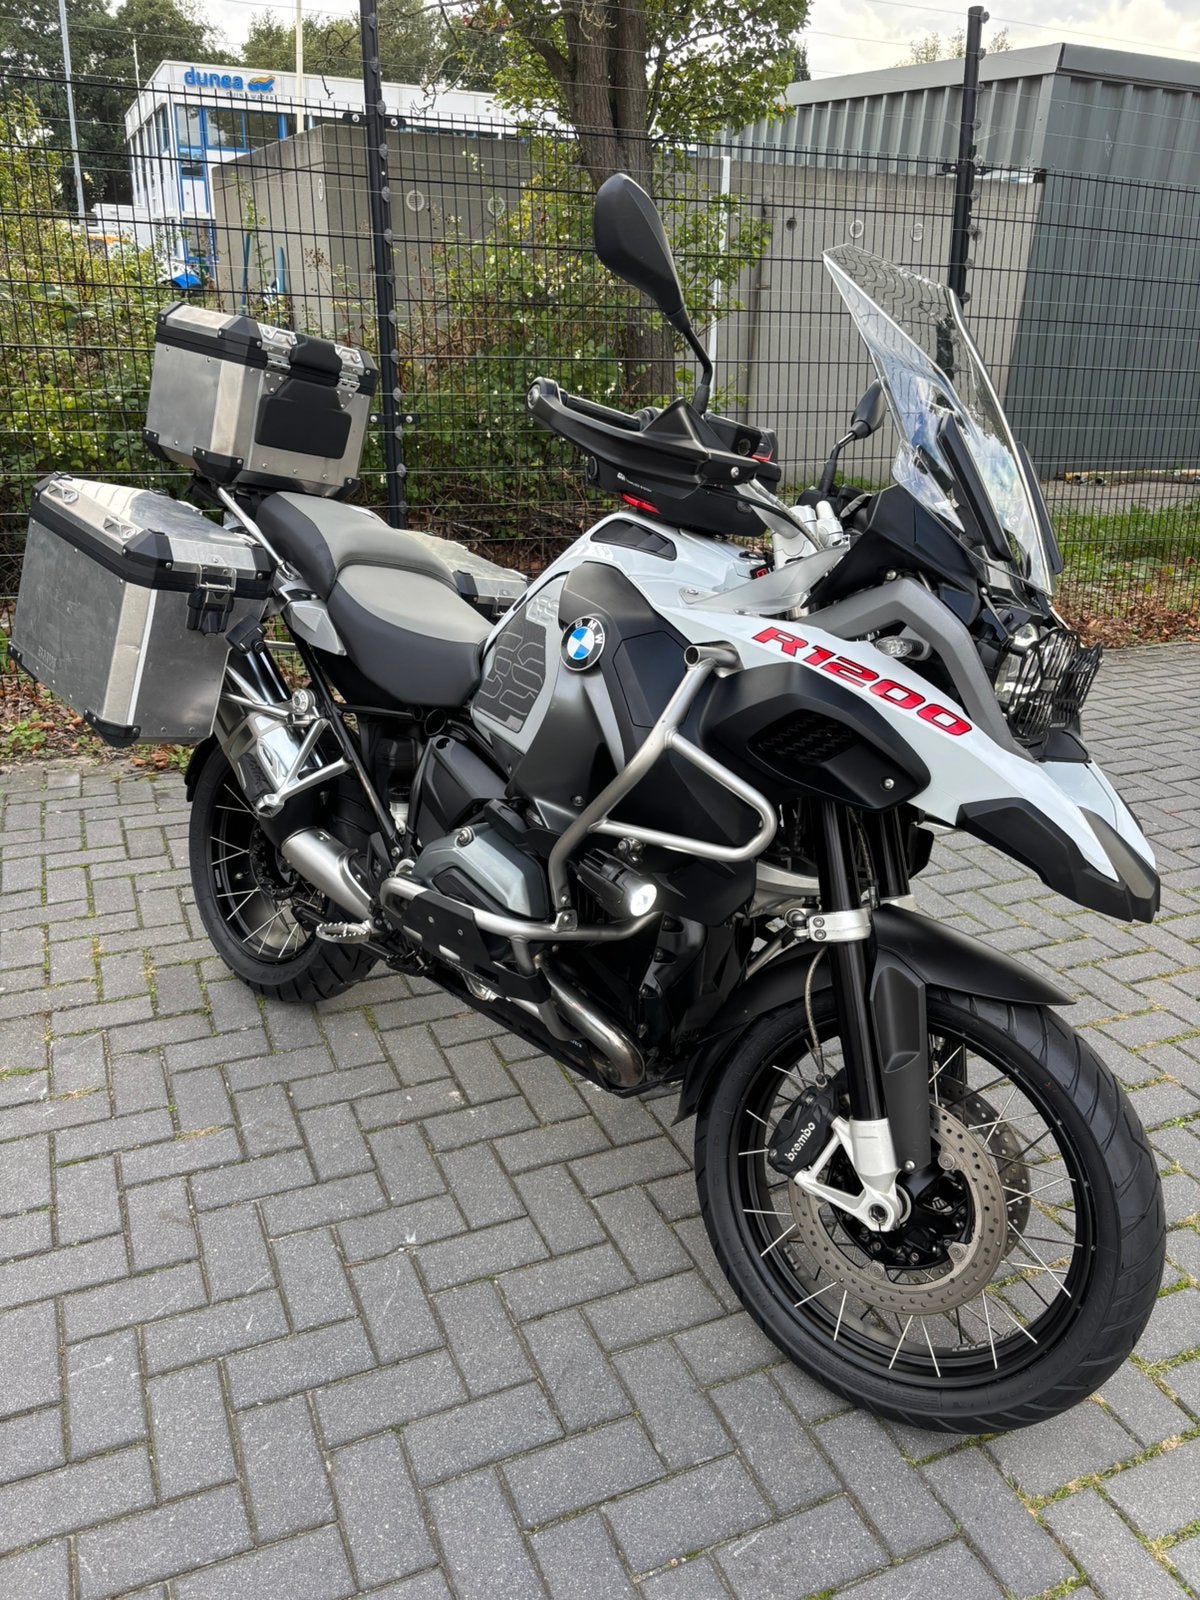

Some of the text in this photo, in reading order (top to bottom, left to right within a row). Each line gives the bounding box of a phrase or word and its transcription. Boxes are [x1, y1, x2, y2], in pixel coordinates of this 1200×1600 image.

[184, 66, 243, 90] dunea
[575, 619, 603, 644] BMW
[752, 626, 973, 736] R1200
[784, 1122, 816, 1162] brembo
